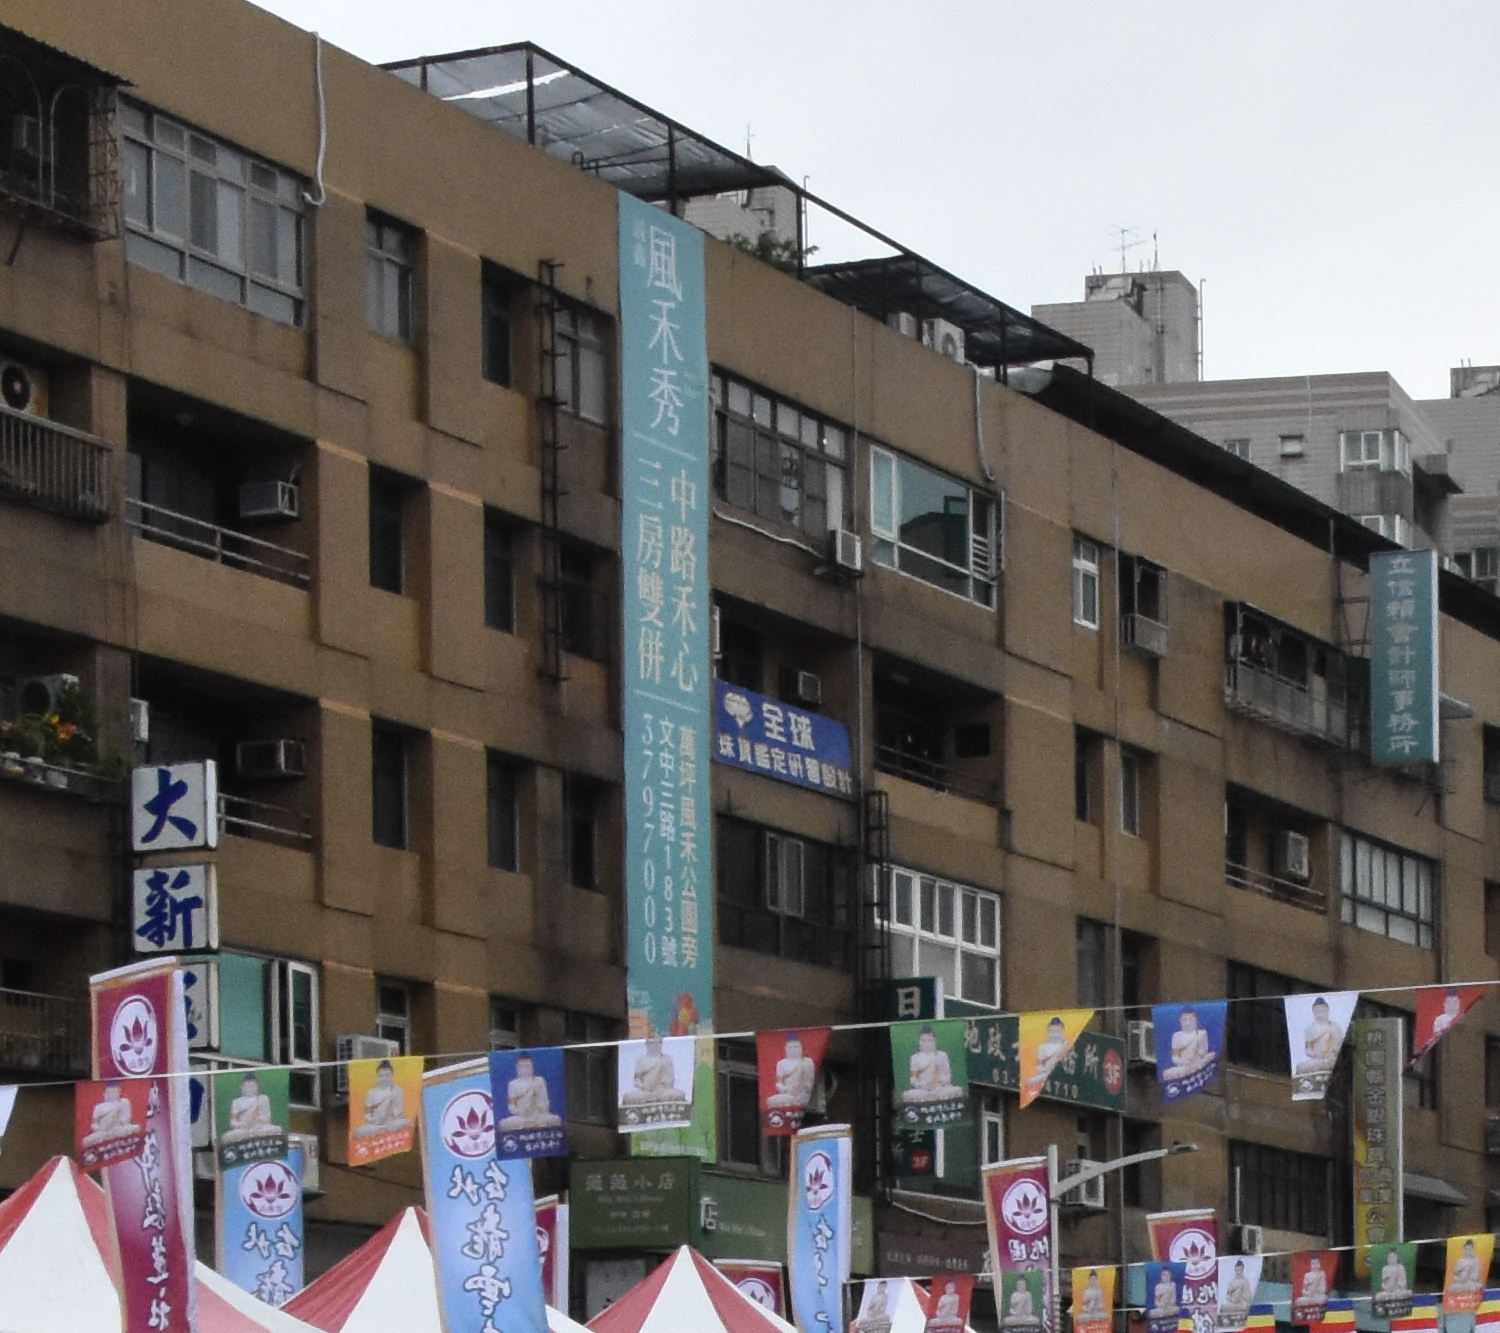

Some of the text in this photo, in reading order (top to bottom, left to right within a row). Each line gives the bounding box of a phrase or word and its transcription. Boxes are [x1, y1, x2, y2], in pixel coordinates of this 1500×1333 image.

[647, 225, 684, 436] 風禾秀
[670, 469, 698, 692] 中路禾心
[762, 702, 816, 751] 全球
